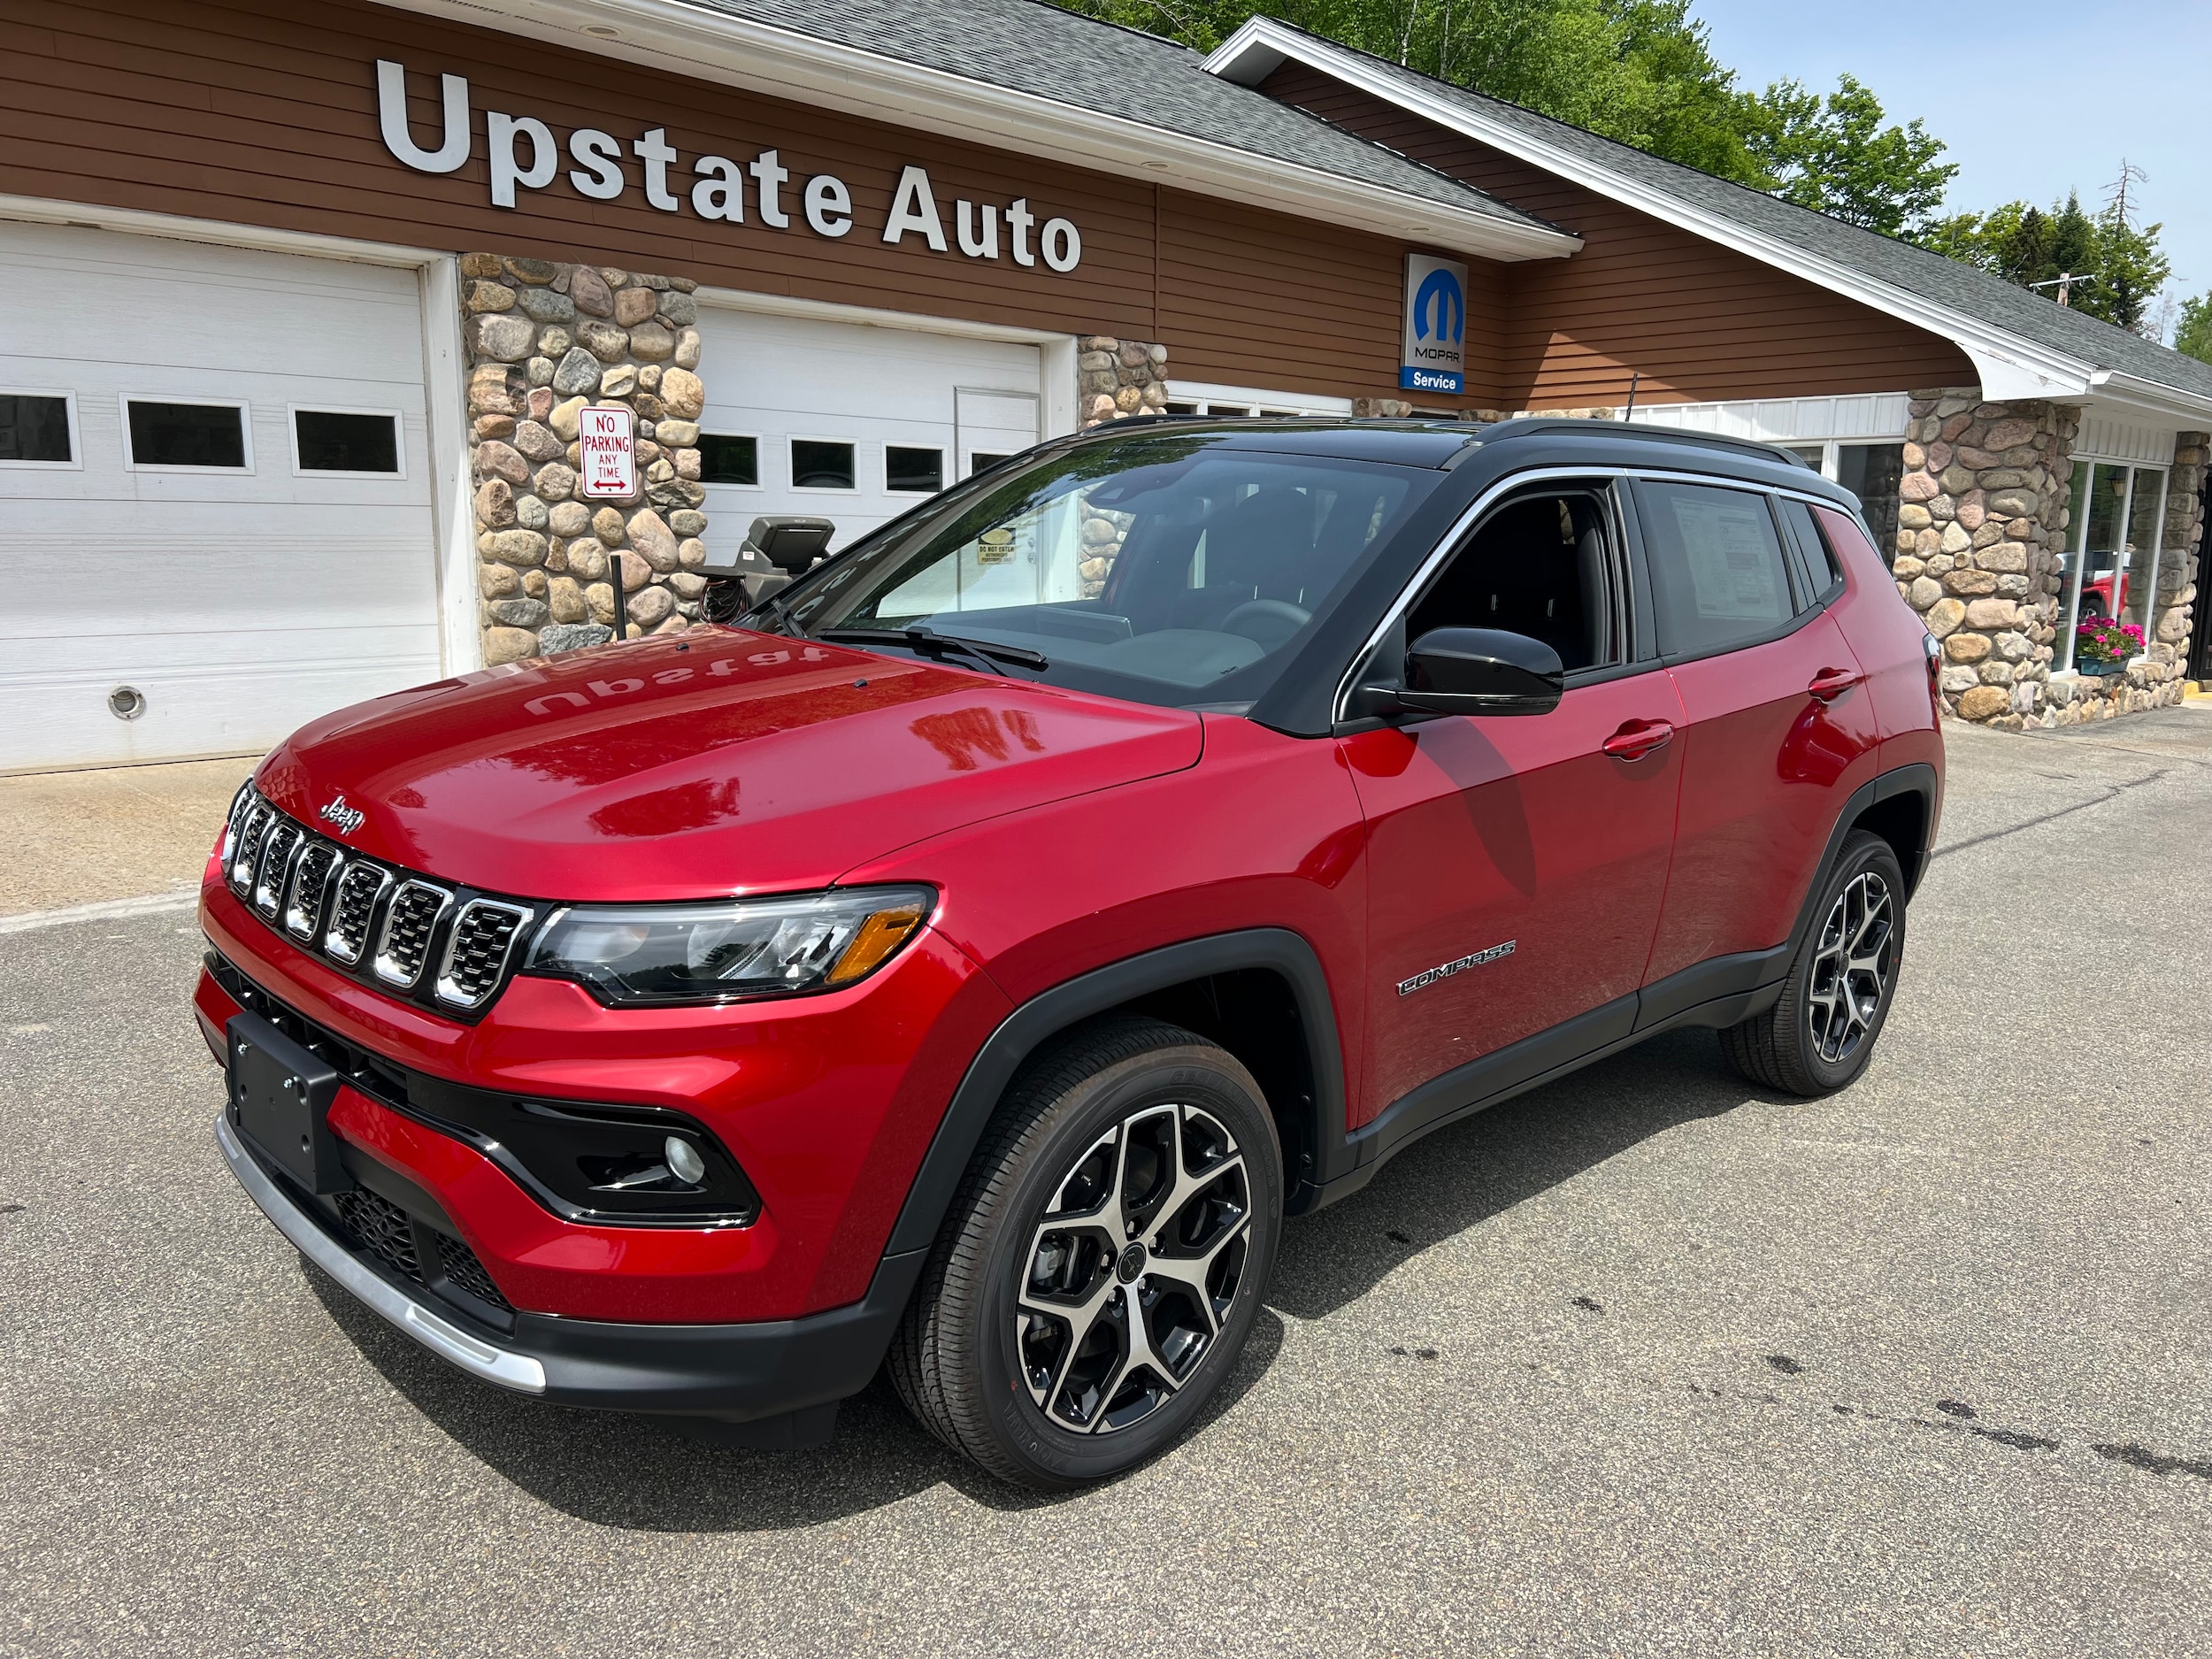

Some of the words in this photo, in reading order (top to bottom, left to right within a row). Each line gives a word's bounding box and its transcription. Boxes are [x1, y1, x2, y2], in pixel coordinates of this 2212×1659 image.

[376, 58, 854, 238] Upstate
[881, 165, 1083, 274] Auto
[1415, 346, 1461, 364] MOPAR
[1413, 372, 1456, 390] Service
[595, 416, 615, 433] NO
[585, 435, 629, 452] PARKING
[598, 454, 618, 465] ANY
[597, 466, 620, 478] TIME
[319, 795, 365, 835] Jeep
[1397, 939, 1517, 996] COMPASS
